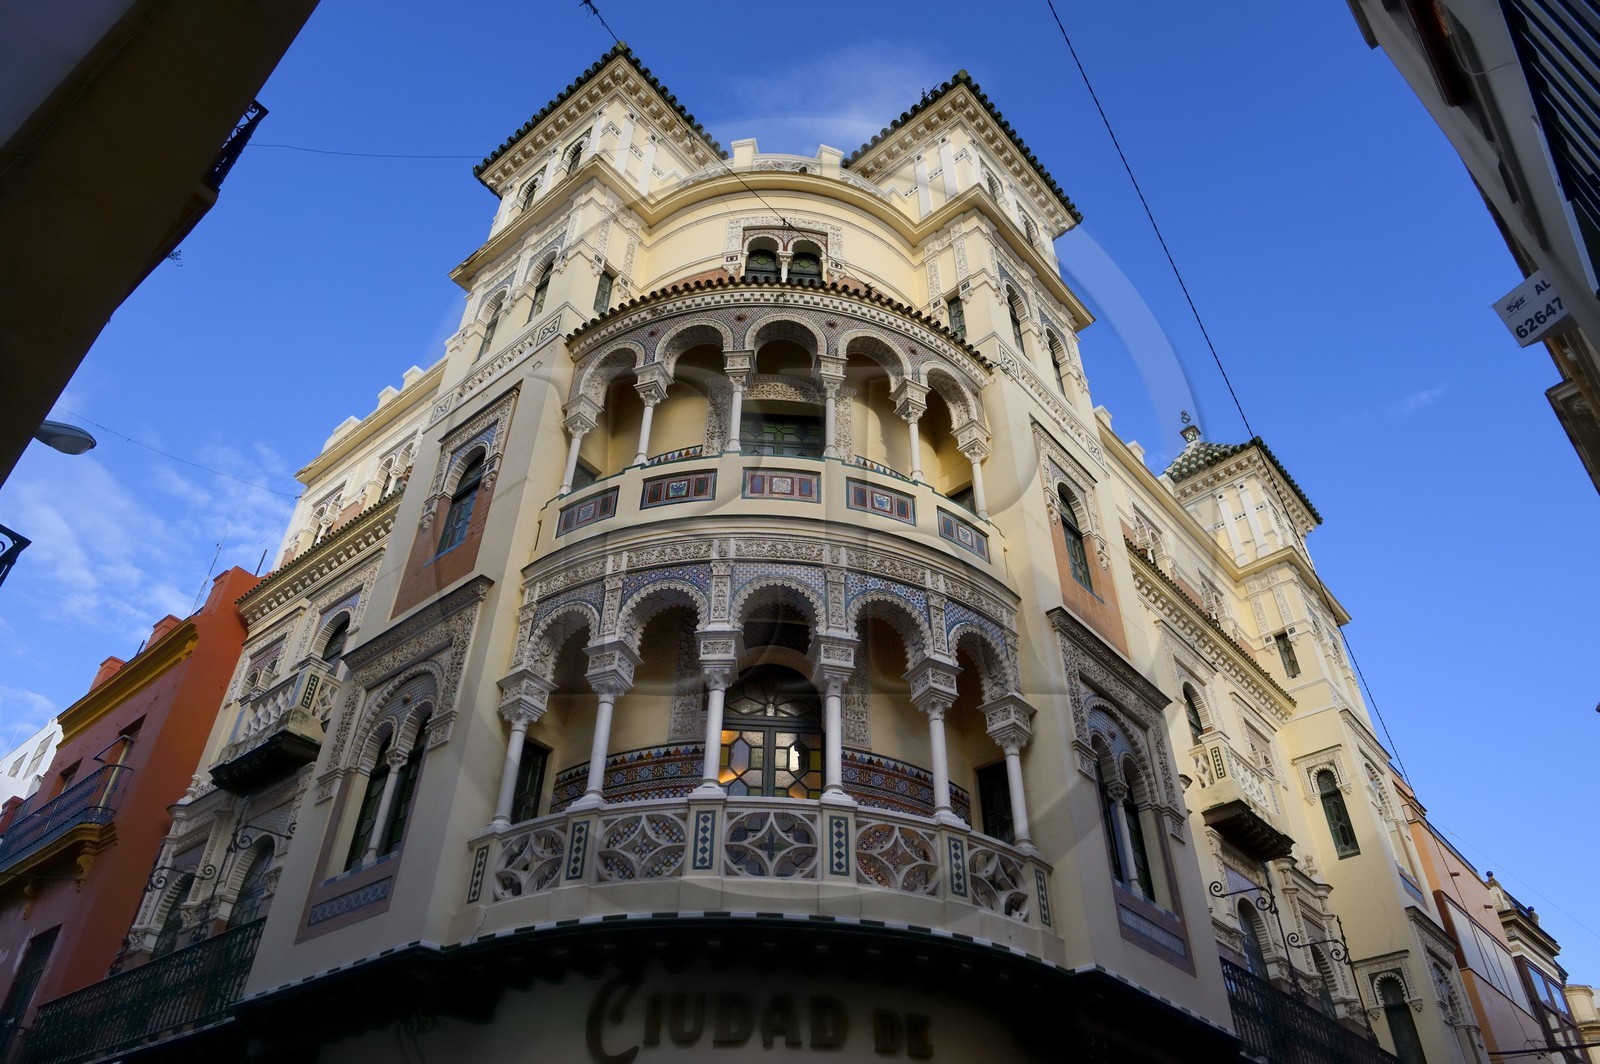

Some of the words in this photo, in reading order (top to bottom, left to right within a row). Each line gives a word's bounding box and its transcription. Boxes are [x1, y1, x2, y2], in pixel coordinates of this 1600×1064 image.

[1515, 296, 1564, 339] 62647
[585, 974, 848, 1064] CIUDAD
[873, 1007, 934, 1059] DE
